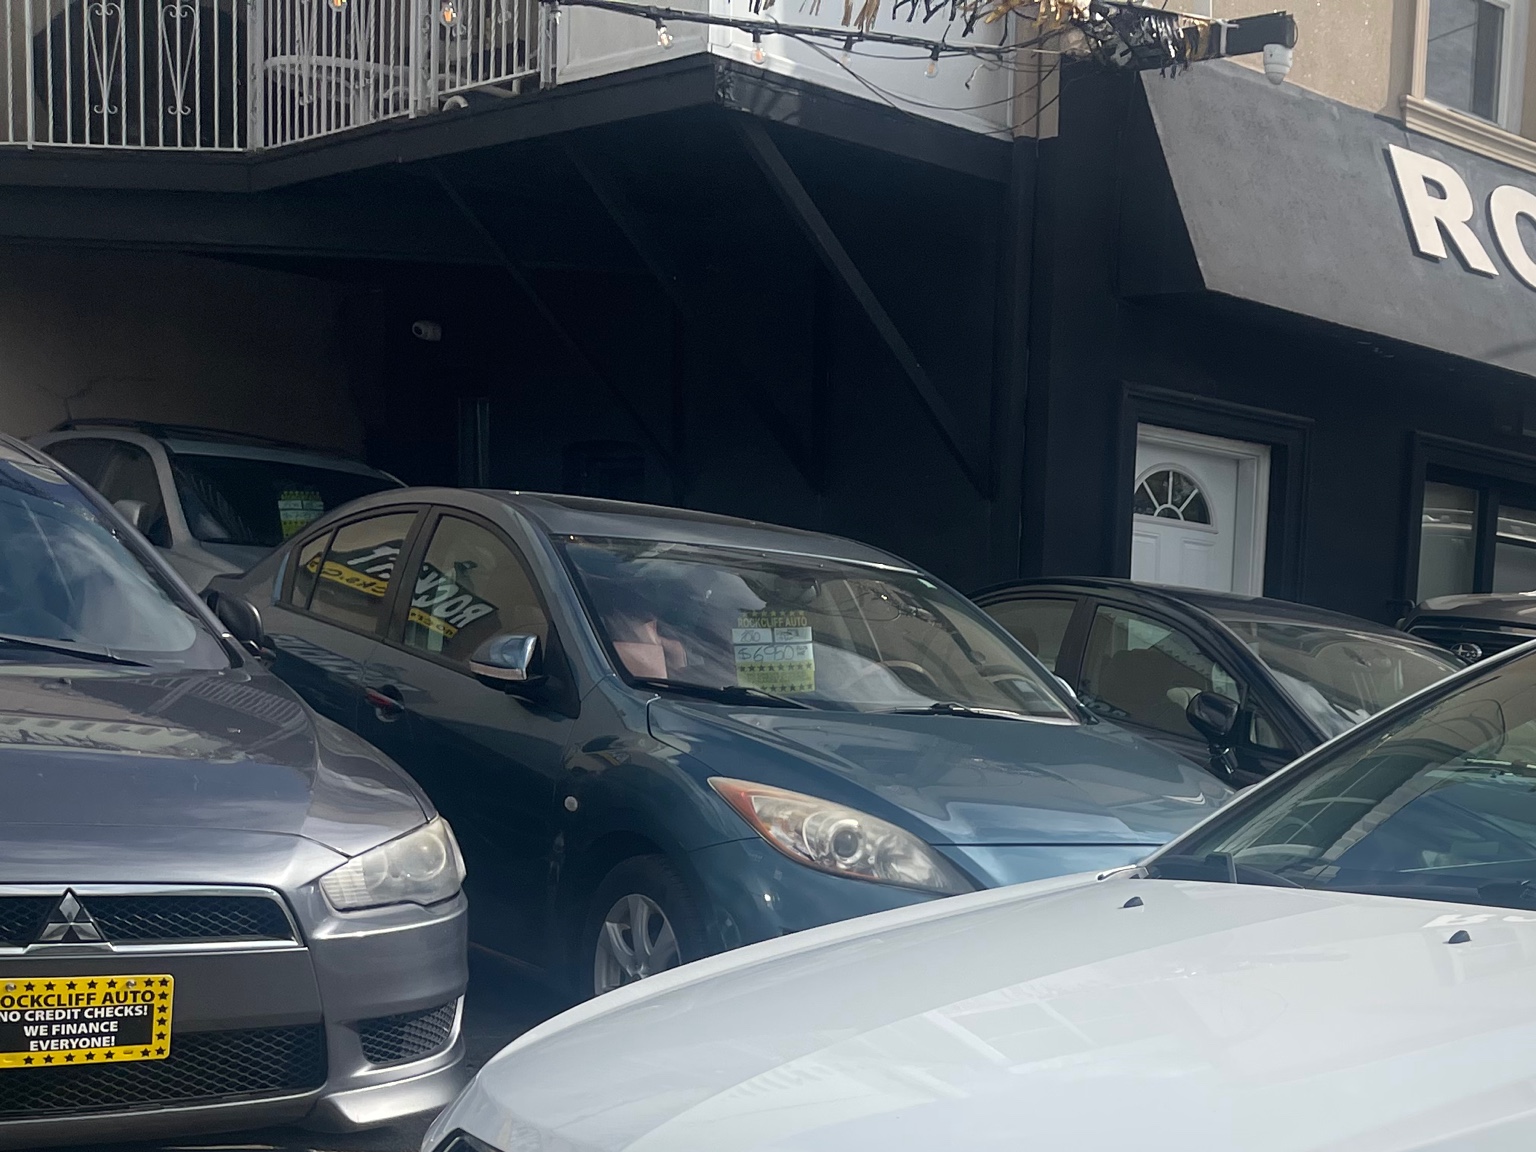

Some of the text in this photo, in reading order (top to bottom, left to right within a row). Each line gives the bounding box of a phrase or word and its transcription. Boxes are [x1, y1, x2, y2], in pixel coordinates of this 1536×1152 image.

[738, 616, 808, 628] ROCKCLIFF AUTO
[0, 990, 156, 1009] OCKCLIFF AUTO
[24, 1008, 81, 1022] CREDIT
[84, 1005, 148, 1019] CHECKS!
[24, 1021, 119, 1037] WE FINANCE
[30, 1035, 116, 1052] EVERYONE!
